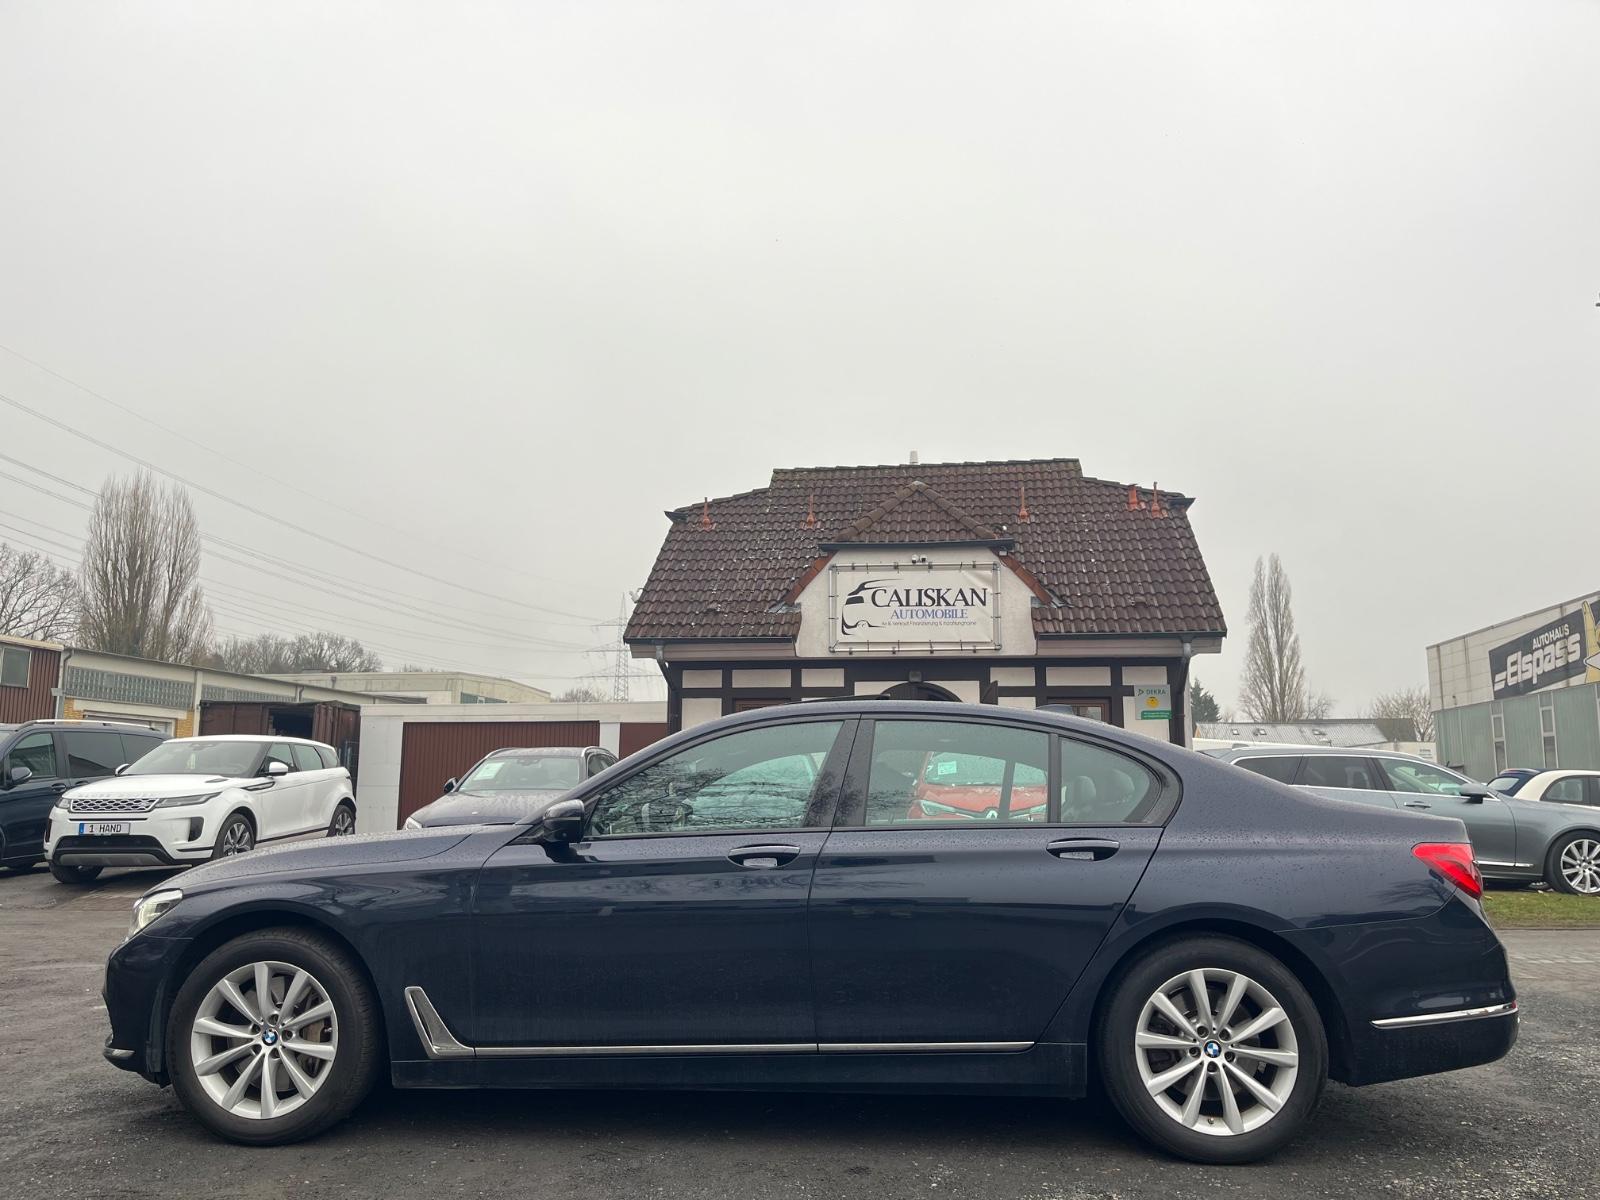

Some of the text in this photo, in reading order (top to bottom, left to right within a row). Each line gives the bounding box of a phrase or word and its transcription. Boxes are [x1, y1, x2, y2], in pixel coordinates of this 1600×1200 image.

[871, 587, 988, 608] CALISKAN
[890, 608, 969, 620] AUTOMOBILE
[1532, 624, 1570, 650] AUTOHAUS
[89, 824, 122, 833] 1 HAND
